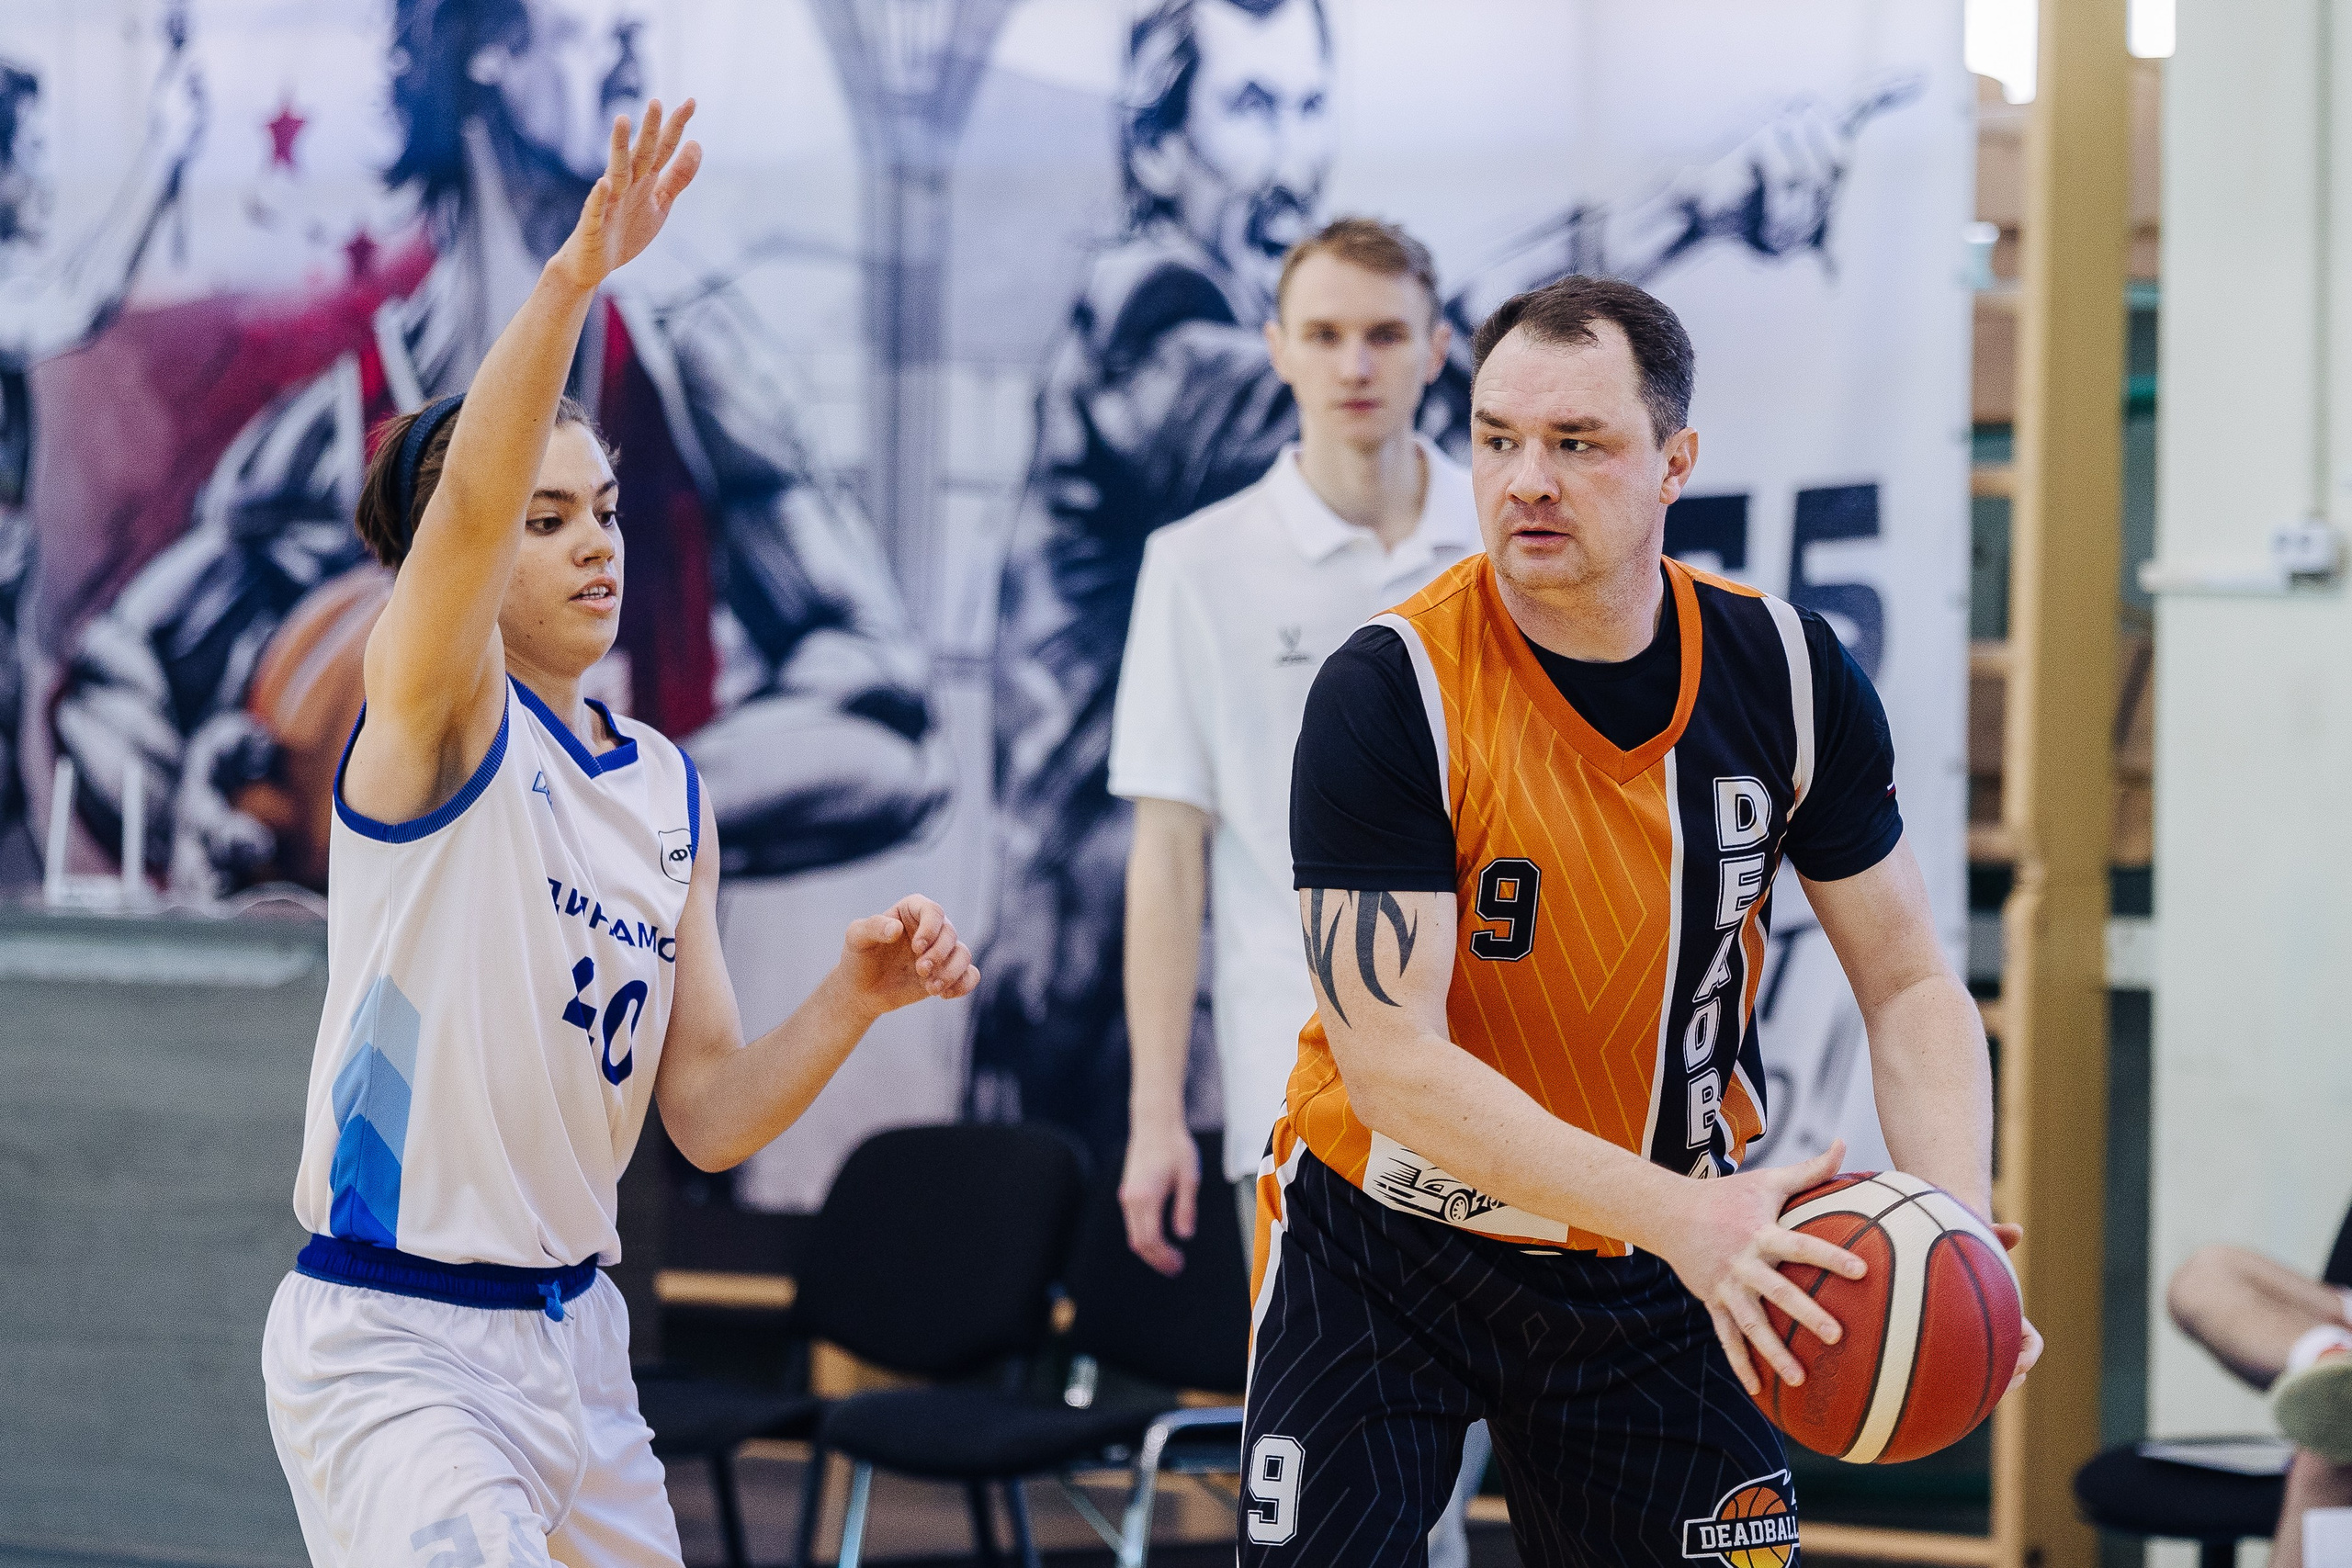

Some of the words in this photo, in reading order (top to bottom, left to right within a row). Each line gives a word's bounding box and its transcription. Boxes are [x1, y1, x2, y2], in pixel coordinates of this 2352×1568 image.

[1470, 857, 1542, 963] 9
[1248, 1434, 1306, 1547] 9
[1699, 1515, 1800, 1550] DEADBALL
